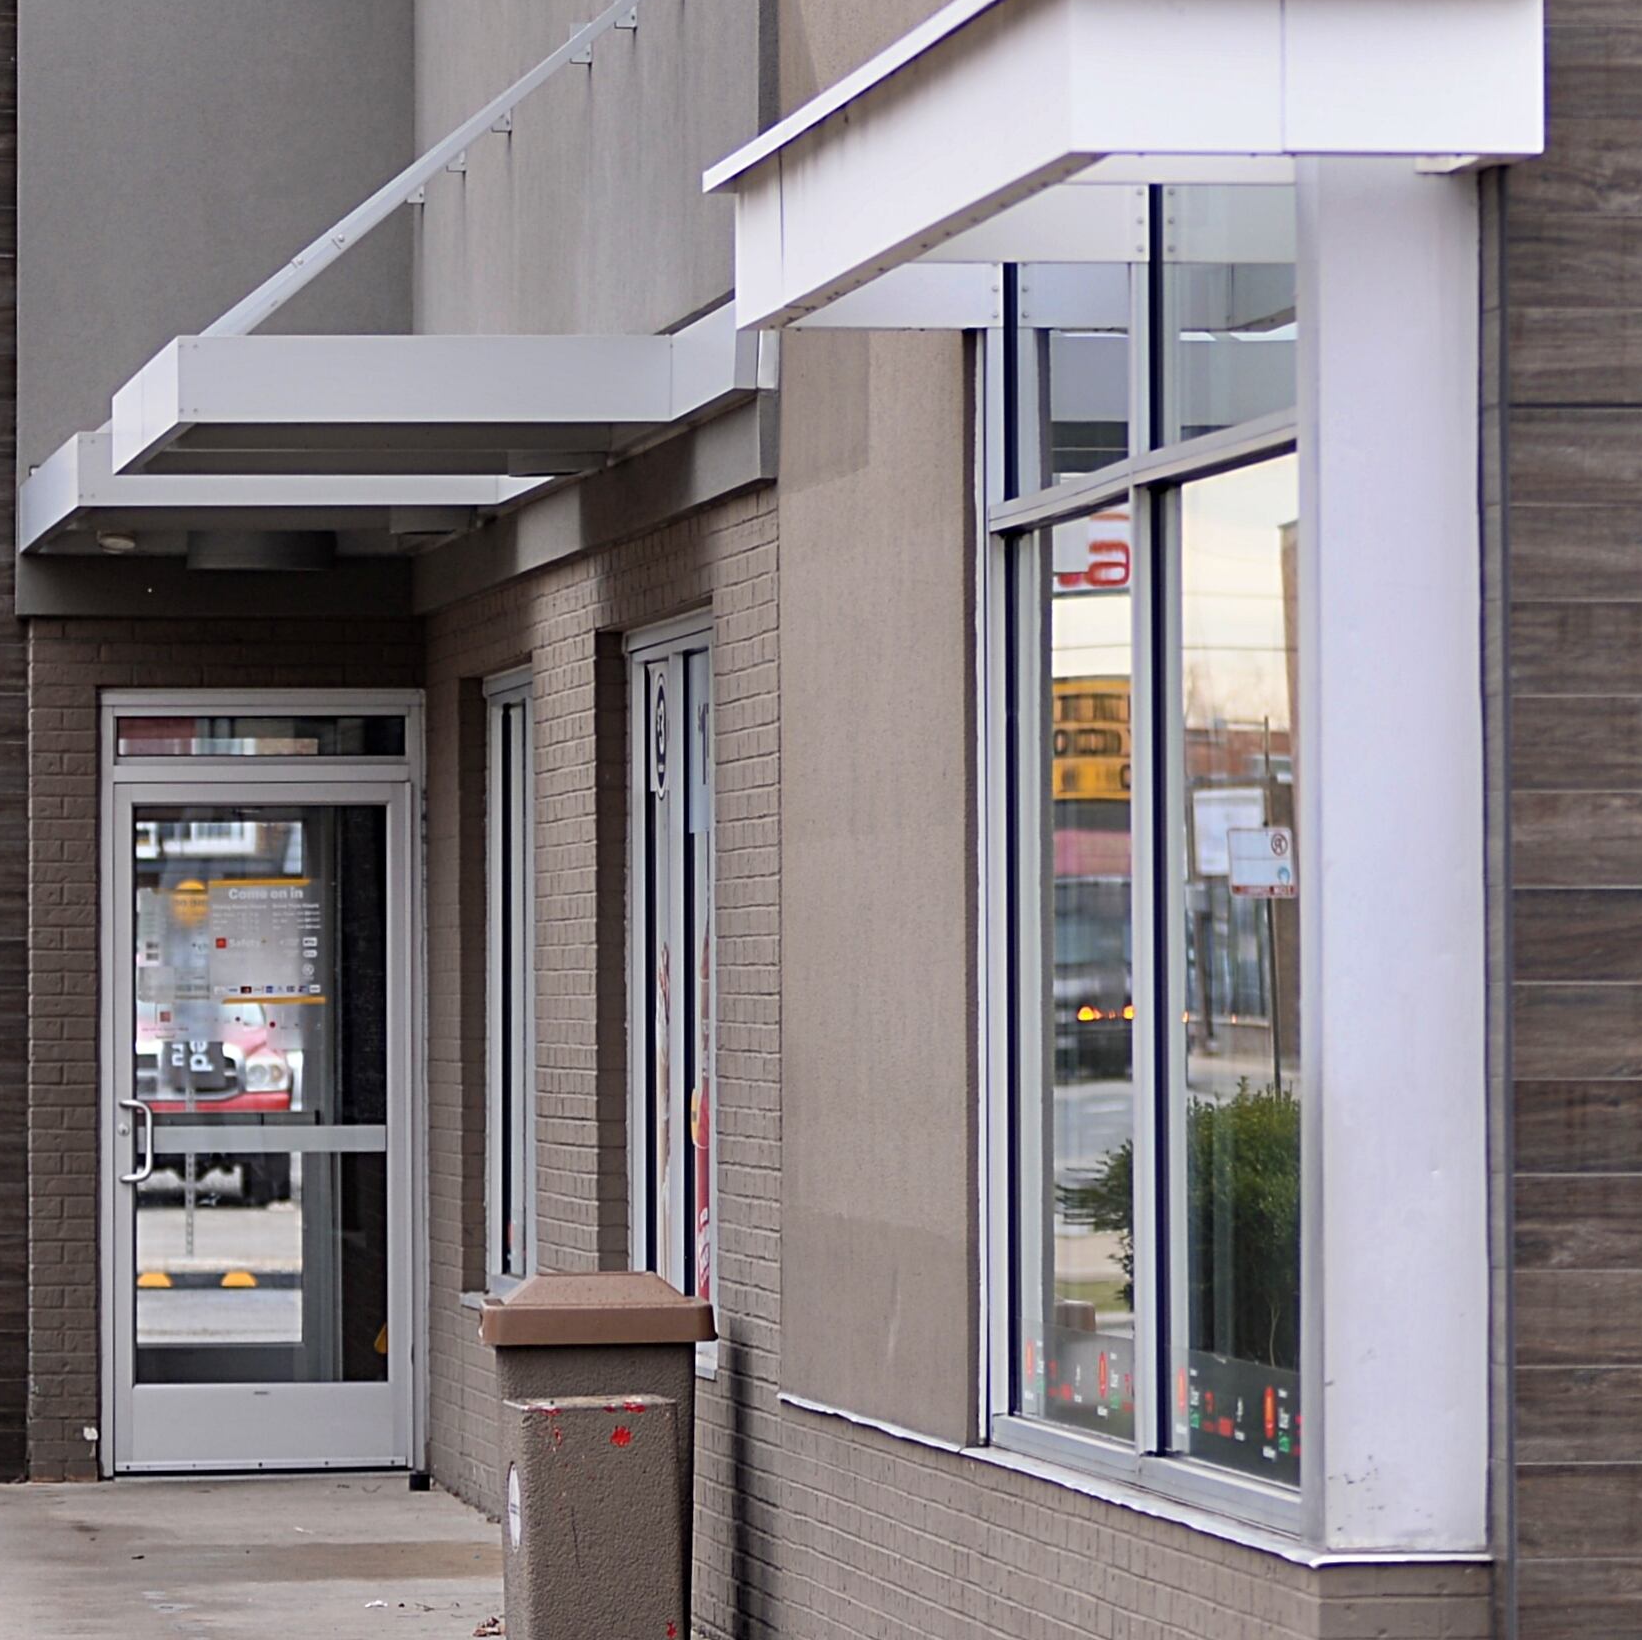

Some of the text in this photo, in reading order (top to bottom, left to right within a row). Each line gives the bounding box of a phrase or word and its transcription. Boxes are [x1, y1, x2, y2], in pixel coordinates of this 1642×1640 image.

[228, 886, 304, 900] Come on in
